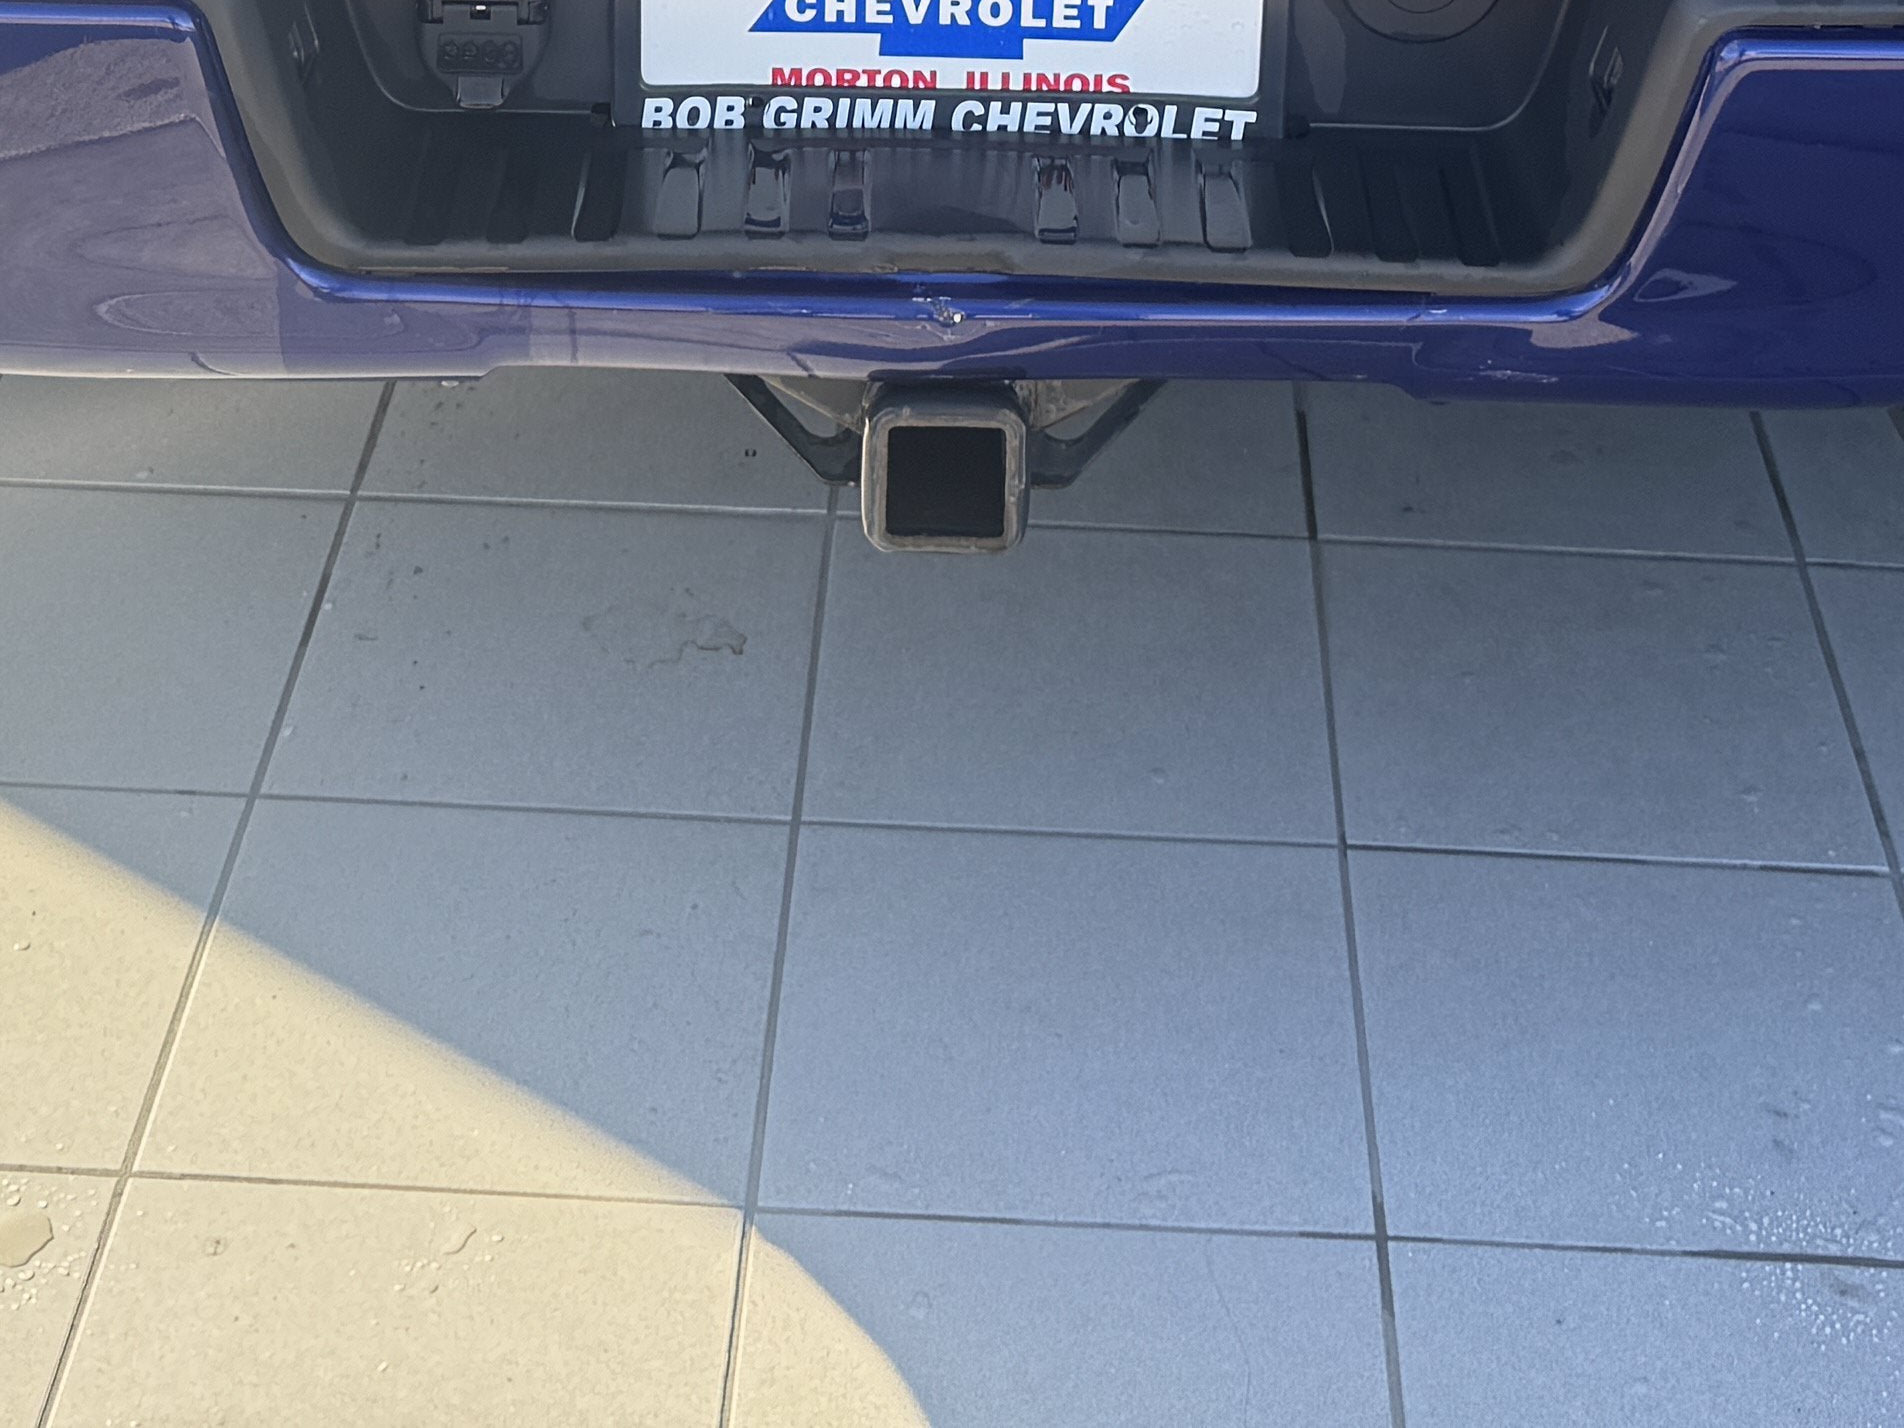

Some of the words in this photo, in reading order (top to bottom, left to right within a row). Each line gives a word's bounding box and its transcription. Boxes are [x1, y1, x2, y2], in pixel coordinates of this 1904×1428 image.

[771, 67, 937, 89] MORTON
[966, 71, 1132, 94] ILLINOIS
[641, 96, 746, 130] BOB
[763, 96, 937, 131] GRIMM
[951, 100, 1258, 141] CHEVROLET
